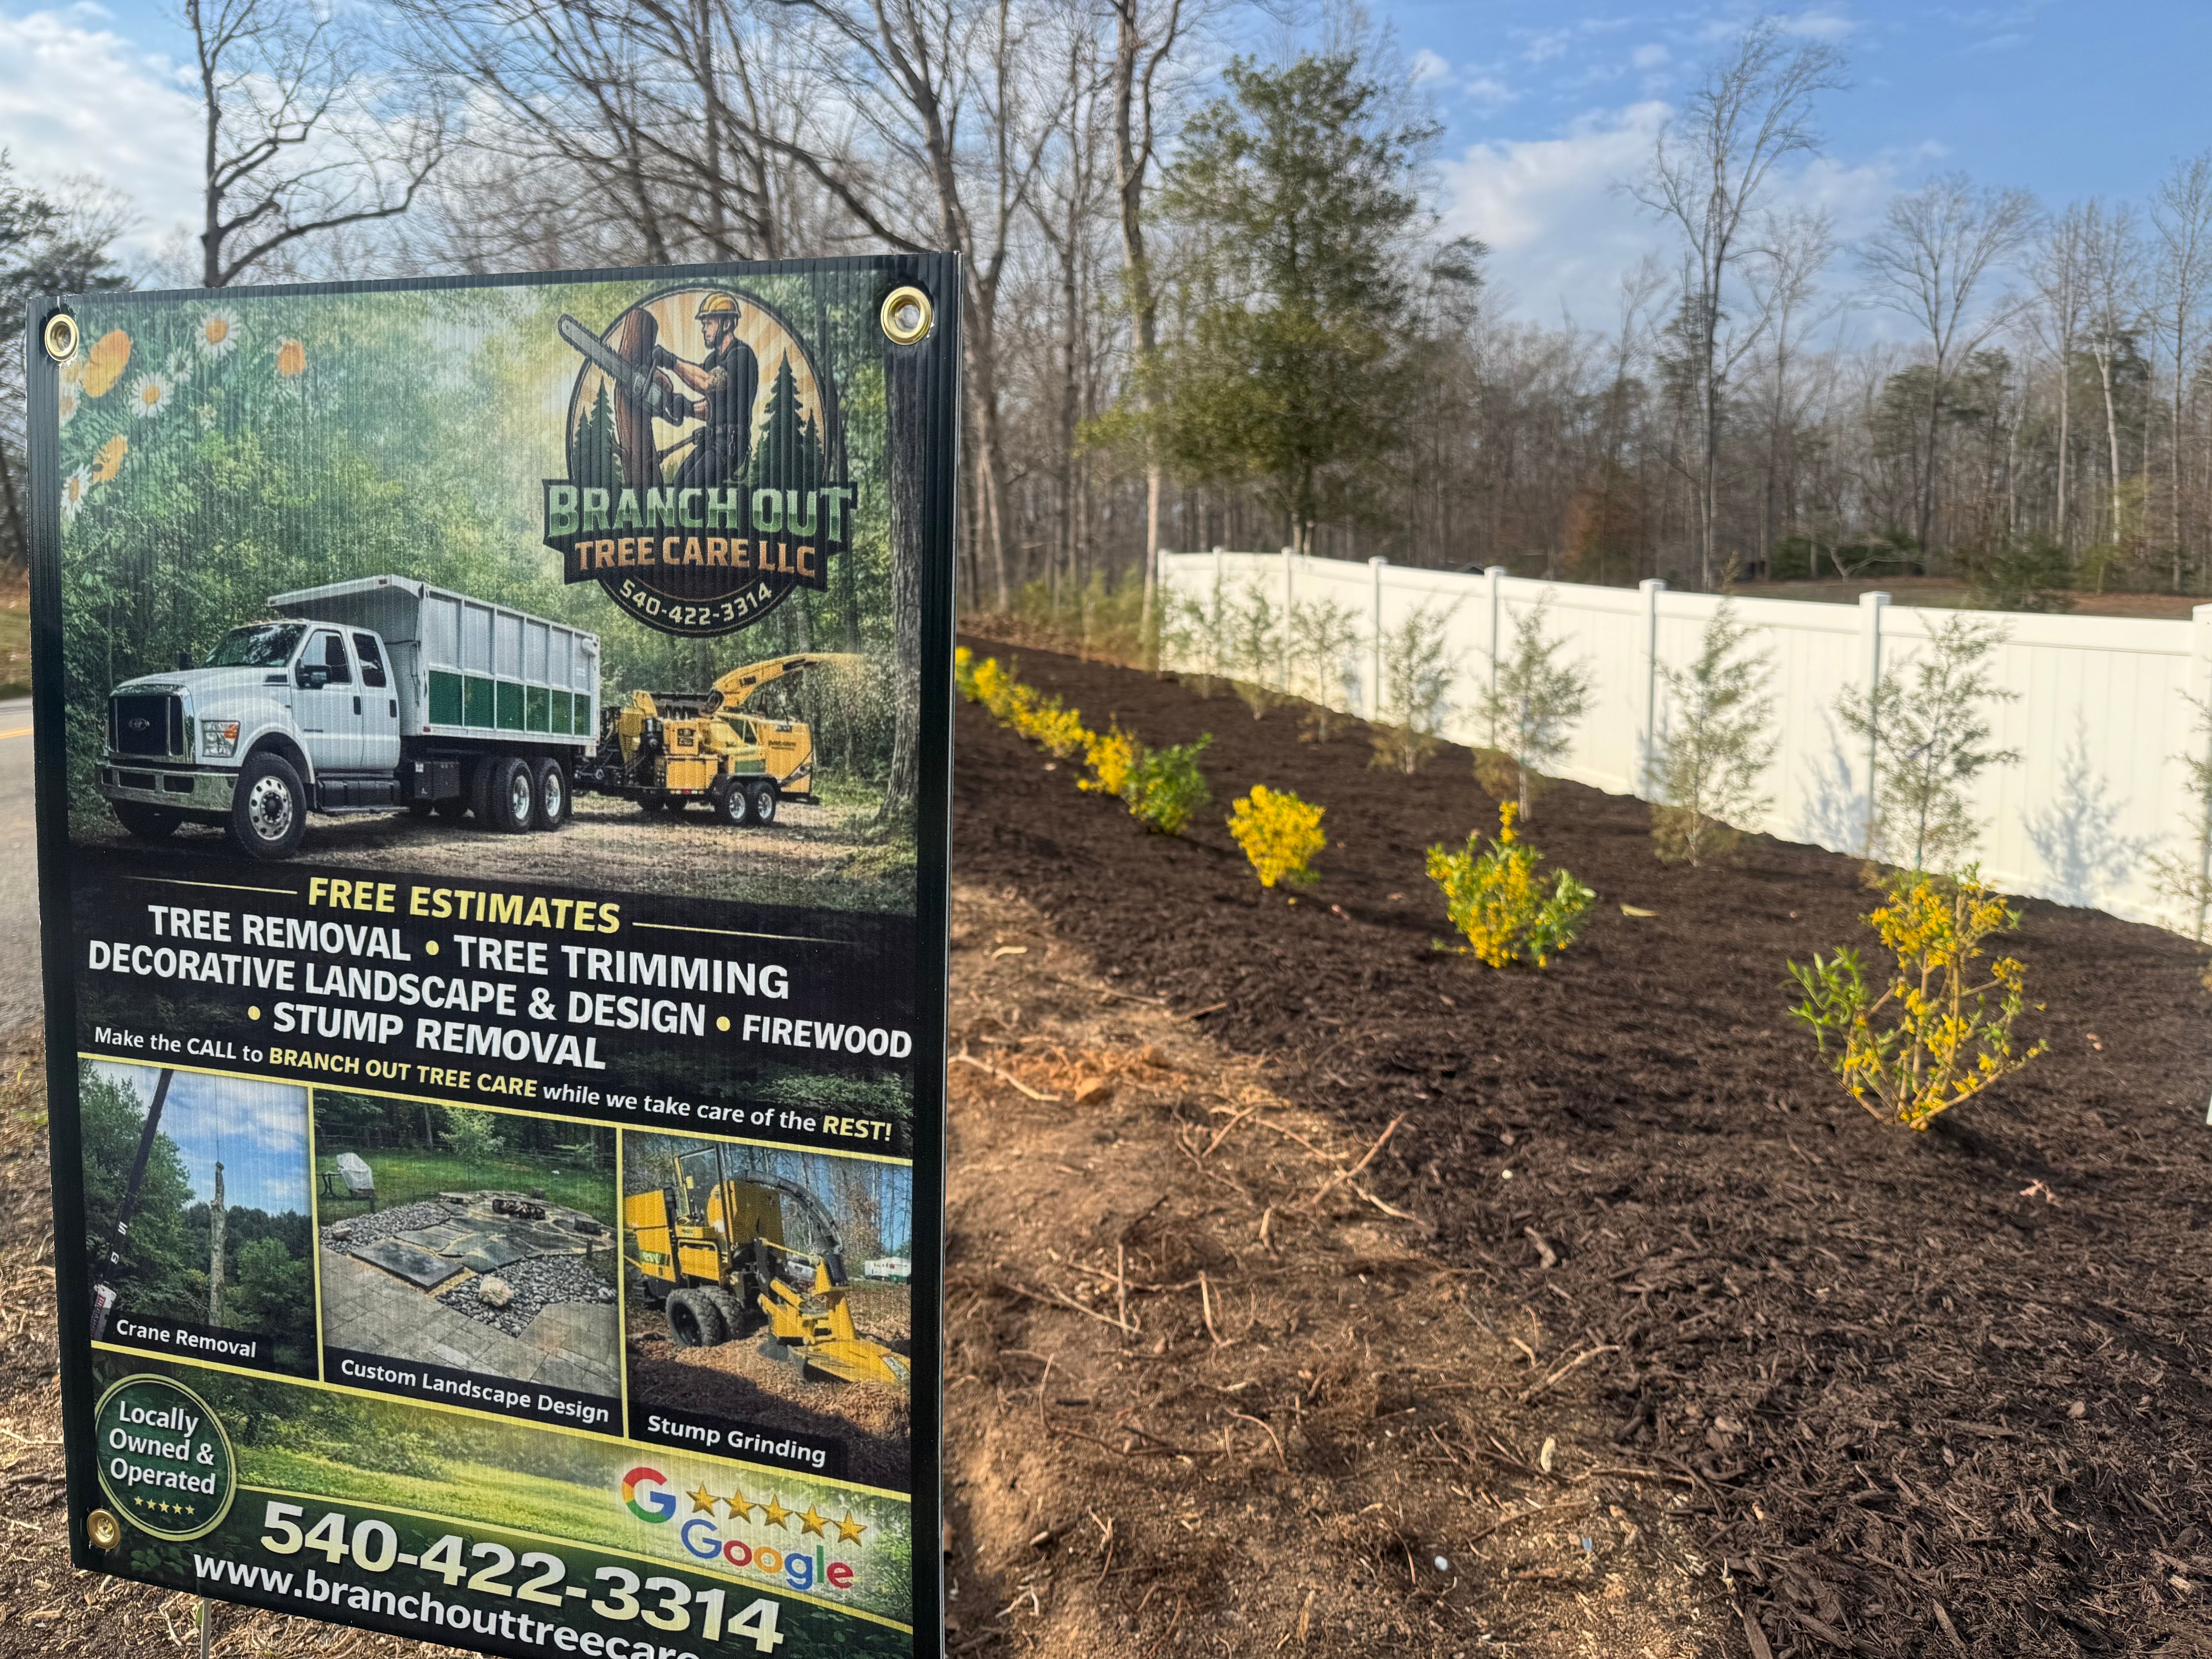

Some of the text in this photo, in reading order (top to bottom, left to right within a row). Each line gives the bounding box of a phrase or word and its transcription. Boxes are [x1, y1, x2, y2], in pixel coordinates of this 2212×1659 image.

[548, 485, 852, 542] BRANCH OUT
[575, 537, 815, 577] TREE CARE LLC
[620, 579, 771, 625] 540-422-3314
[309, 878, 620, 933] FREE ESTIMATES
[148, 905, 788, 999] TREE REMOVAL TREE TRIMMING
[89, 940, 912, 1058] DECORATIVE LANDSCAPE & DESIGN FIREWOOD
[274, 1002, 605, 1069] STUMP REMOVAL
[95, 1027, 891, 1141] Make the CALL to BRANCH OUT TREE CARE while we take care of the REST!
[117, 1320, 256, 1357] Crane Removal
[120, 1401, 199, 1437] Locally
[342, 1360, 608, 1423] Custom Landscape Design
[110, 1428, 214, 1465] Owned &
[648, 1416, 825, 1467] Stump Grinding
[111, 1458, 215, 1494] Operated
[261, 1501, 784, 1654] 540-422-3314
[681, 1518, 854, 1590] Google
[194, 1554, 700, 1659] www.branchouttreecar
